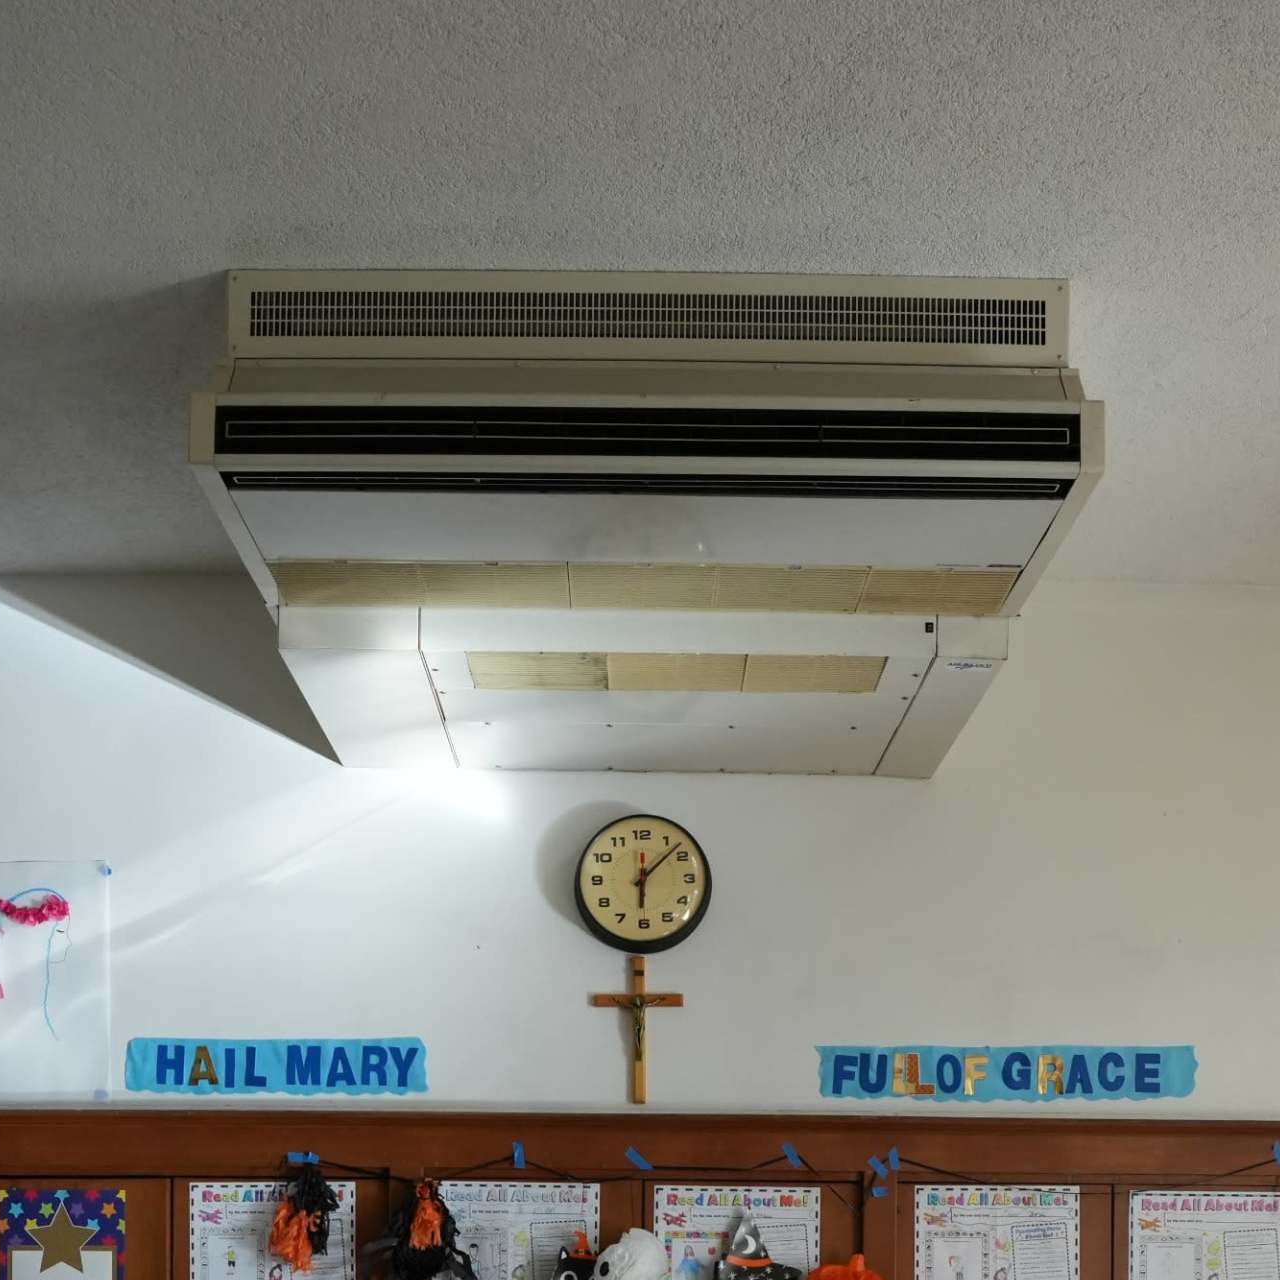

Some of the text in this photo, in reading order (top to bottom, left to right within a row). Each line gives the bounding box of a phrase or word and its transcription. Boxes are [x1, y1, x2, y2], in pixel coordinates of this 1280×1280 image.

[632, 830, 651, 840] 12
[611, 837, 626, 847] 11
[663, 836, 670, 846] 1
[593, 853, 612, 863] 10
[677, 851, 688, 861] 2
[592, 875, 603, 885] 9
[683, 873, 695, 884] 3
[599, 898, 610, 907] 8
[677, 896, 688, 905] 4
[615, 914, 626, 923] 7
[662, 912, 673, 922] 5
[638, 919, 650, 929] 6
[156, 1044, 419, 1088] HAIL MARY
[1001, 1052, 1161, 1095] GRACE
[202, 1189, 239, 1203] Read
[242, 1189, 264, 1202] All
[666, 1193, 704, 1206] Read
[707, 1193, 727, 1206] All
[731, 1193, 777, 1207] About
[927, 1193, 964, 1206] Read
[967, 1193, 988, 1206] All
[992, 1193, 1037, 1206] About
[1141, 1199, 1177, 1212] Read
[1180, 1199, 1201, 1212] All
[1204, 1199, 1248, 1212] About
